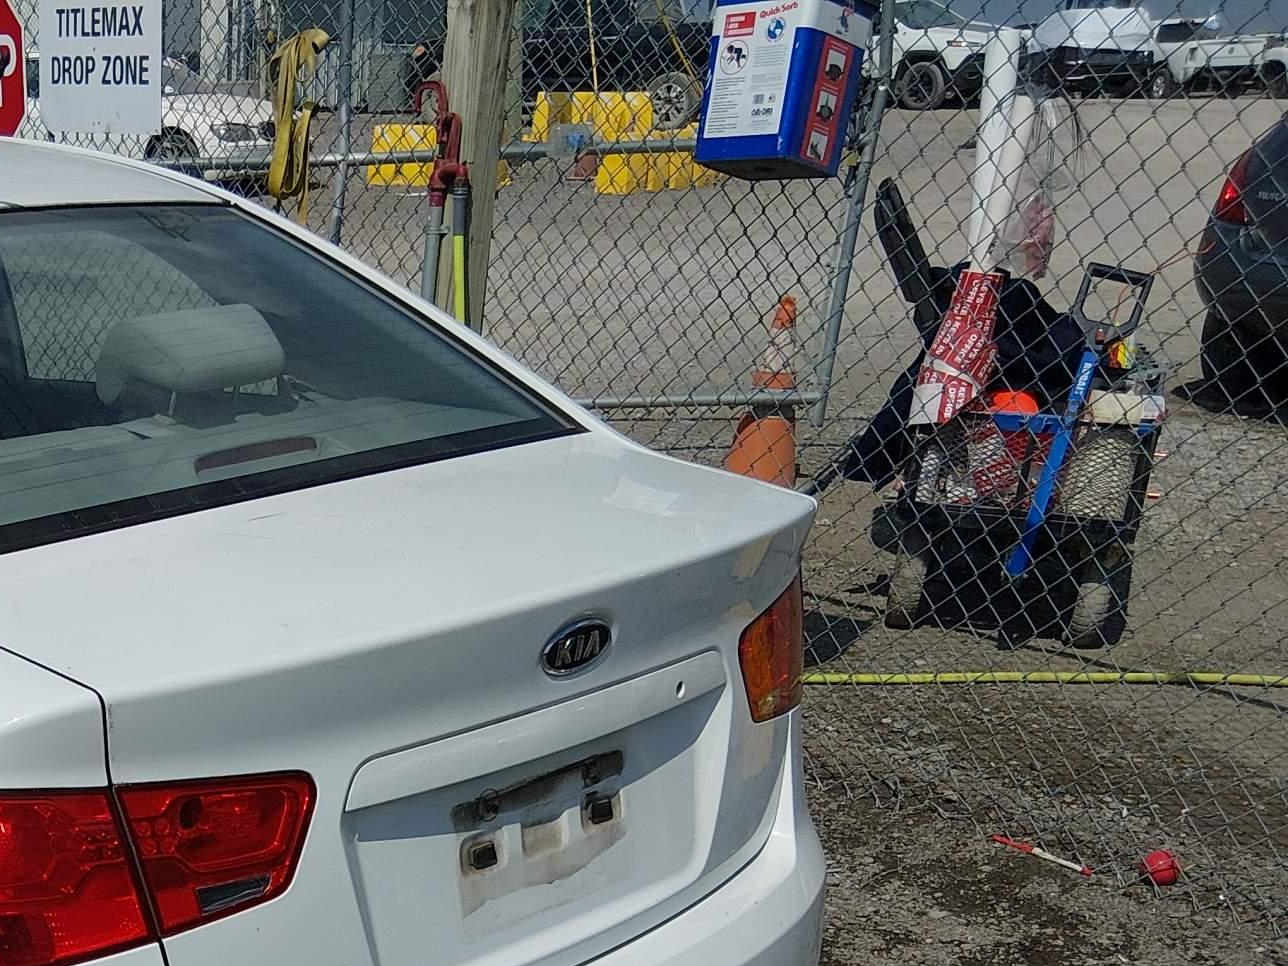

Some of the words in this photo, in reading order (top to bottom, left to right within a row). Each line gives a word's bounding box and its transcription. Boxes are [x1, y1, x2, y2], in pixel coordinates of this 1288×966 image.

[55, 6, 144, 38] TITLEMAX
[759, 7, 781, 19] Quick
[781, 1, 799, 12] Sorb
[51, 55, 96, 86] DROP
[101, 55, 150, 86] ZONE
[554, 630, 600, 667] KIA
